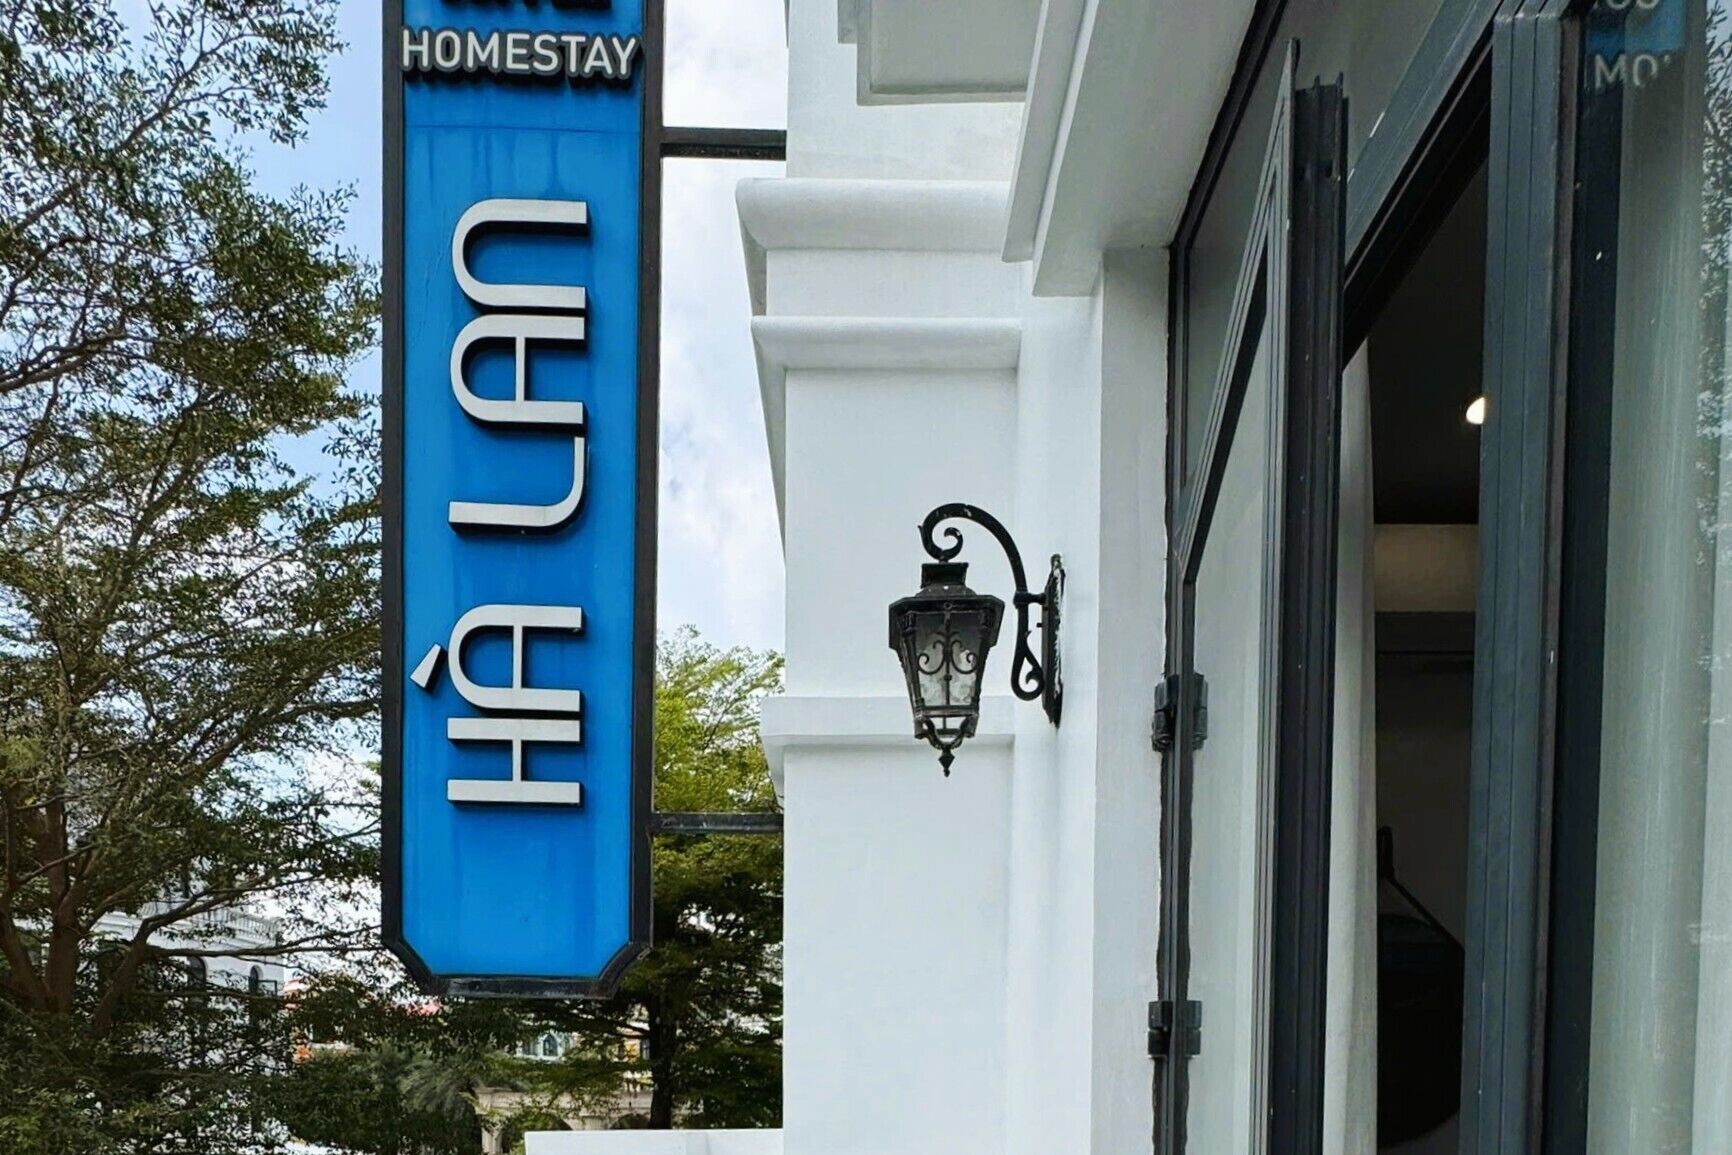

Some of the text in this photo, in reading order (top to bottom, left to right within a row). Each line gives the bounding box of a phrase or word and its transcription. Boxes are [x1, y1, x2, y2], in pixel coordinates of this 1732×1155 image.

[402, 29, 637, 76] HOMESTAY
[448, 197, 588, 528] LAN
[409, 604, 583, 804] HÀ
